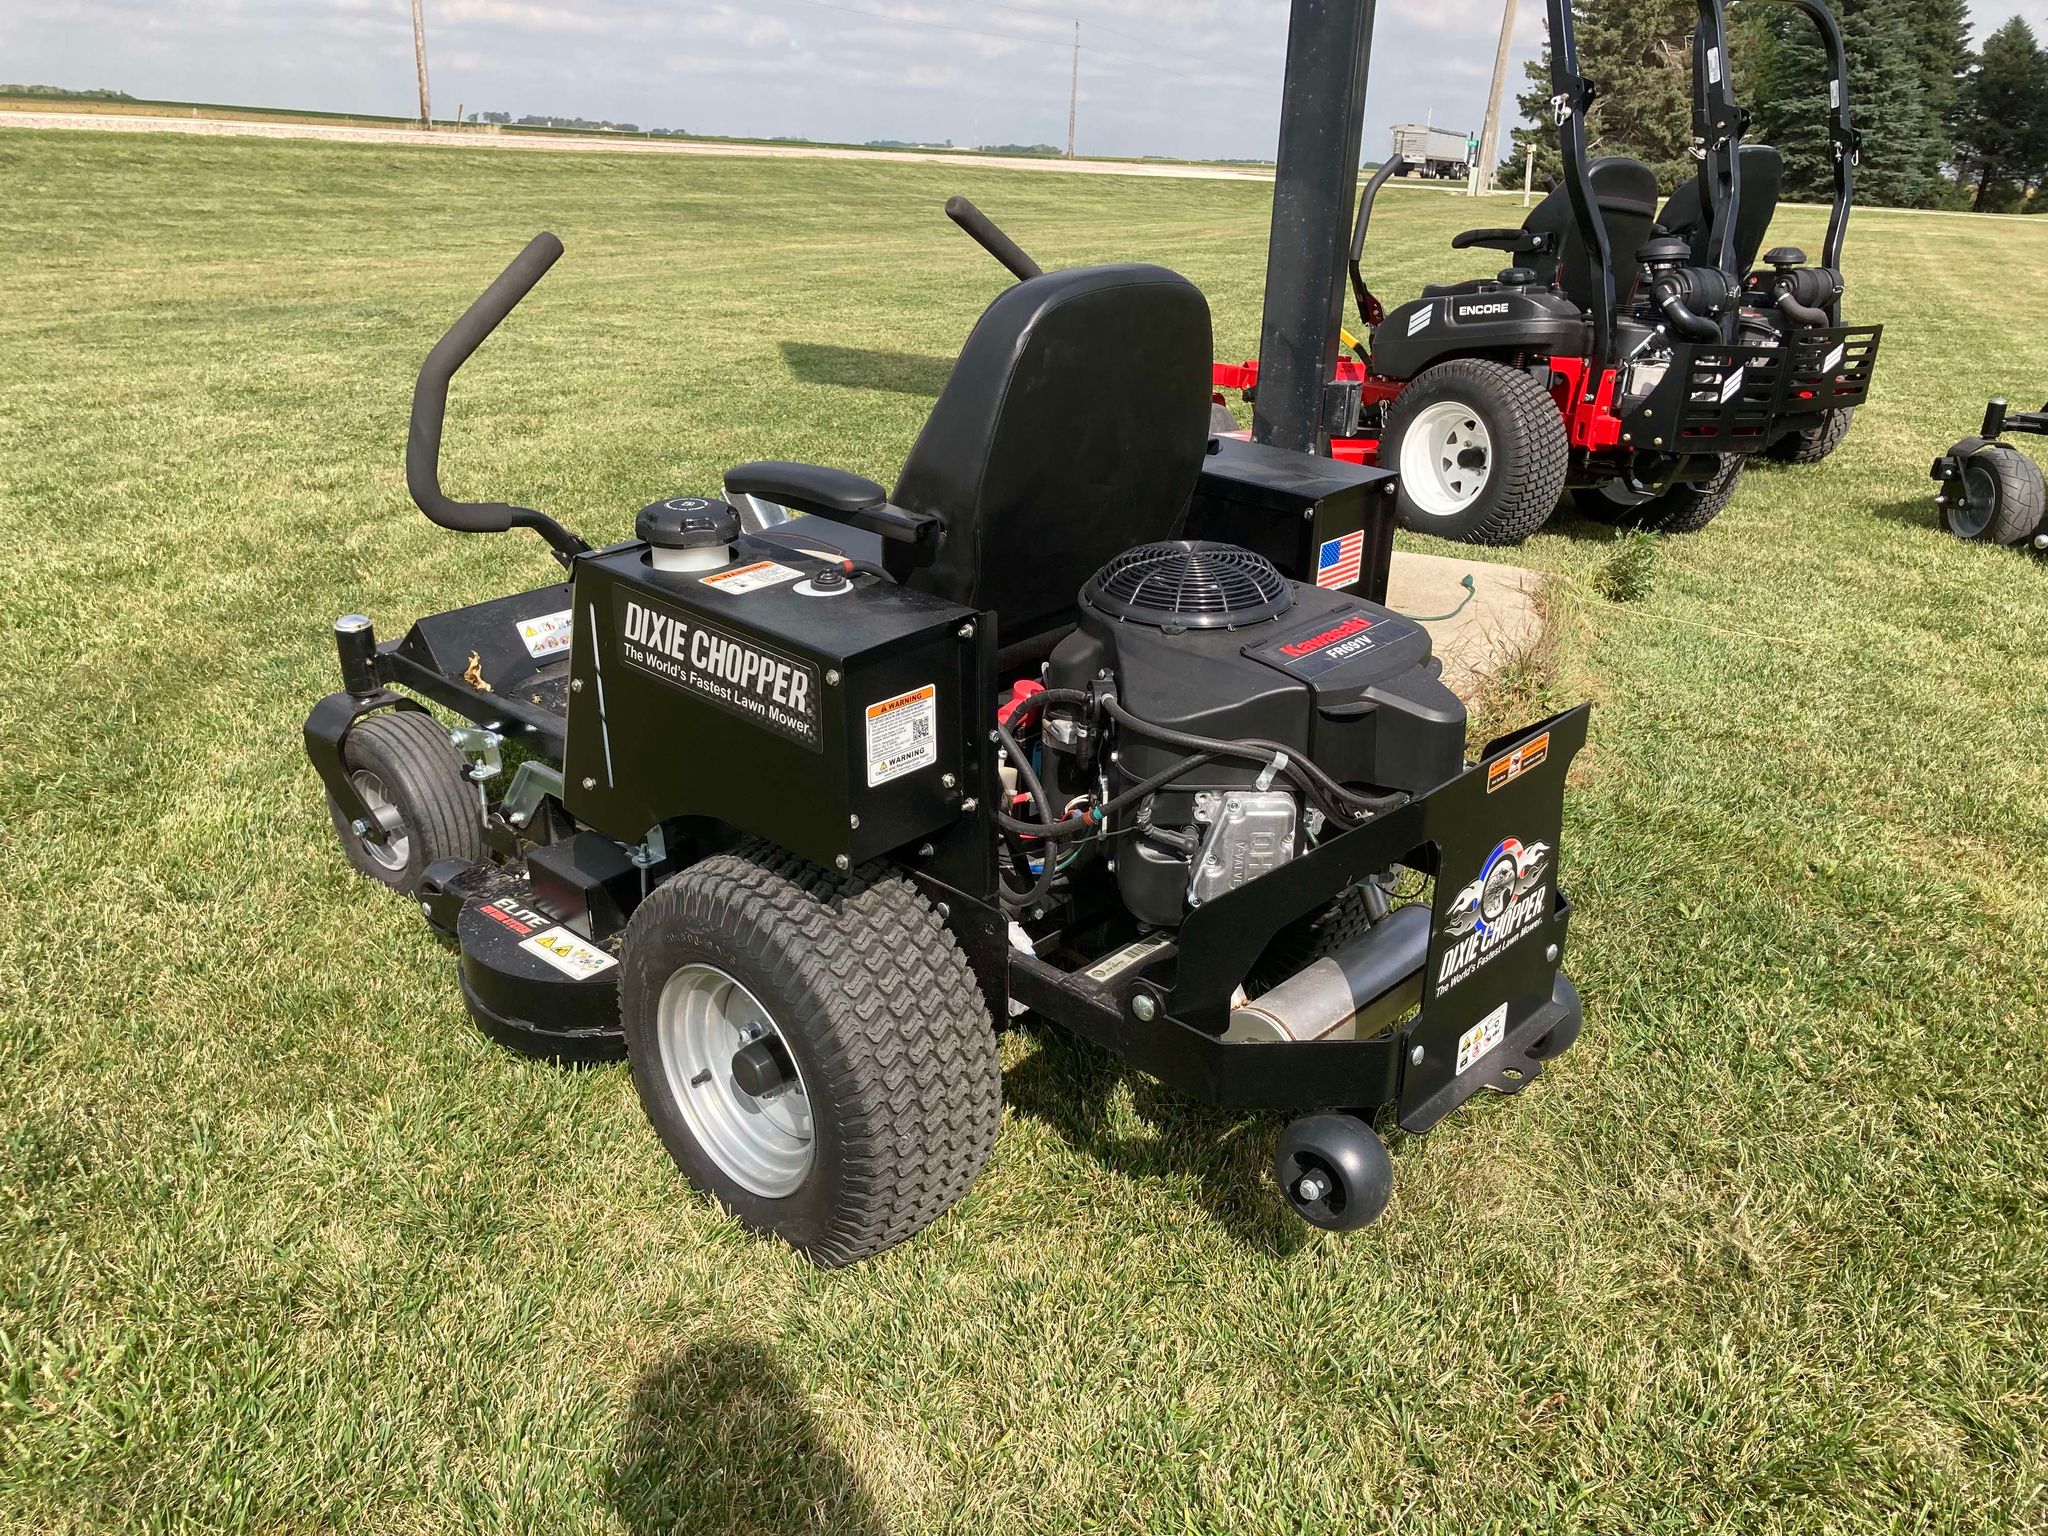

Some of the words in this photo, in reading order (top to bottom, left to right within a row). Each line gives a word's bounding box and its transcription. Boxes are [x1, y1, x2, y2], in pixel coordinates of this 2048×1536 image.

[1459, 303, 1509, 316] ENCORE
[1279, 616, 1373, 657] Kawasaki
[1325, 635, 1372, 659] FR691V
[624, 601, 688, 661] DIXIE
[691, 629, 808, 713] CHOPPER
[624, 642, 644, 662] The
[646, 652, 687, 681] World's
[689, 670, 732, 701] Fastest
[734, 690, 765, 716] Lawn
[768, 705, 810, 734] Mower
[889, 693, 922, 710] WARNING
[889, 747, 925, 766] WARNING
[492, 898, 551, 928] ELITE
[1439, 929, 1483, 984] DIXIE
[1481, 885, 1546, 952] CHOPPER
[1436, 984, 1449, 998] The
[1450, 963, 1476, 988] World's
[1477, 944, 1501, 969] Fastest
[1501, 933, 1520, 951] Lawn
